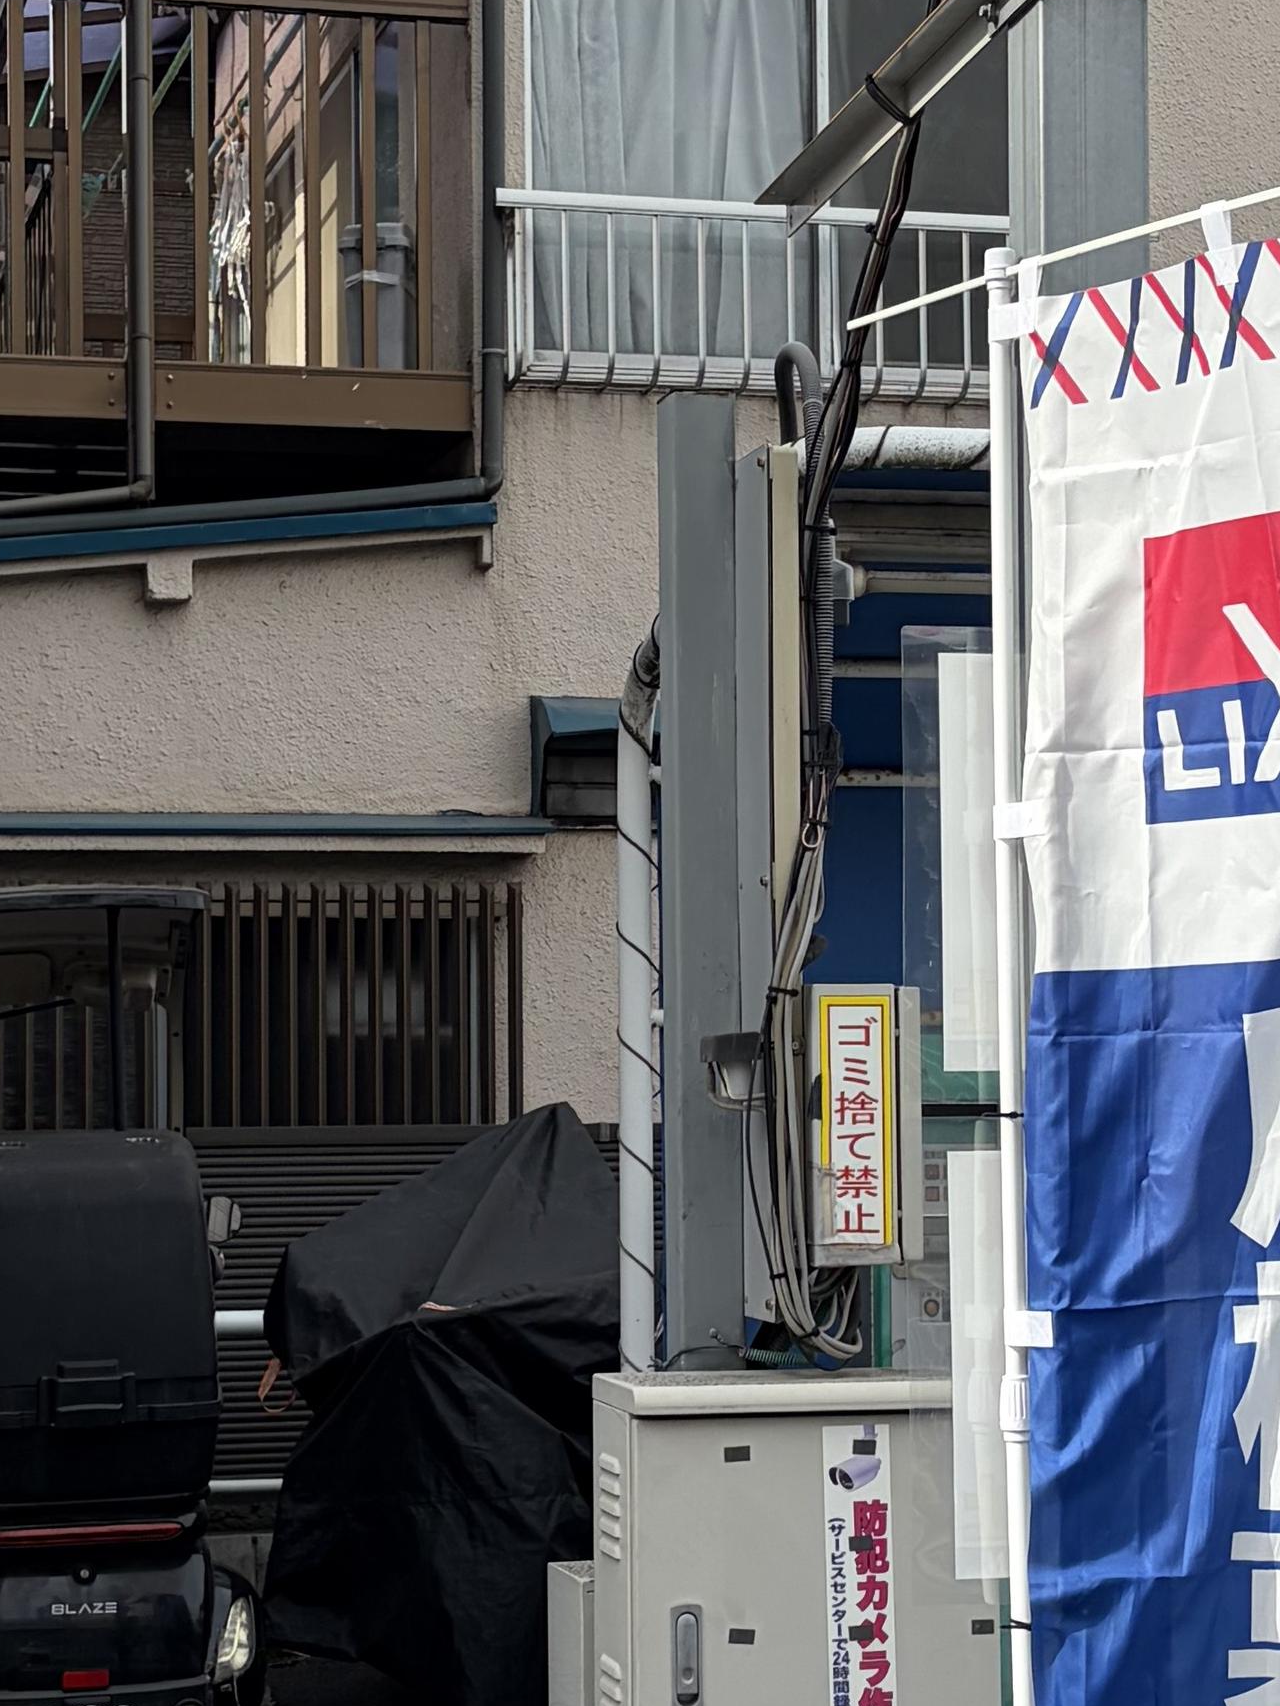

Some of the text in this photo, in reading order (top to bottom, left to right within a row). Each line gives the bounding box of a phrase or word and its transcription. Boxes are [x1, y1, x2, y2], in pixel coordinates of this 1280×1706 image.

[834, 1015, 881, 1235] ゴミ捨て禁止
[50, 1601, 118, 1615] BLAZE
